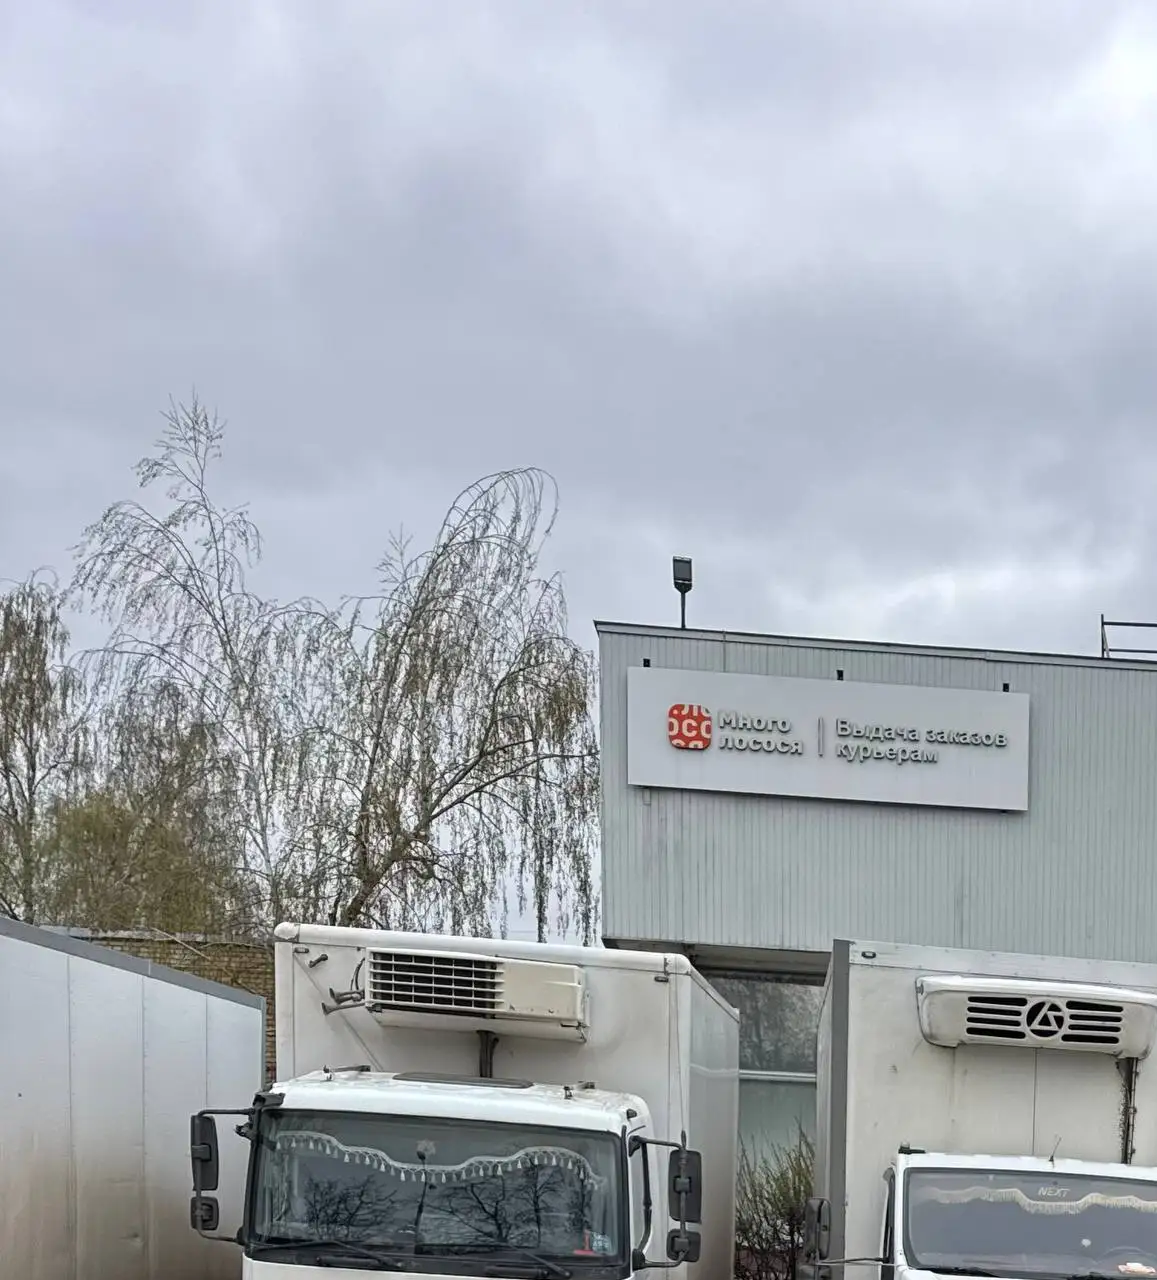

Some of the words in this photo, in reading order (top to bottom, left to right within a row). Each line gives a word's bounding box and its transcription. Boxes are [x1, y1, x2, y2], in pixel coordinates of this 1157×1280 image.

[836, 718, 920, 742] Выдача
[926, 727, 1008, 747] заказов
[719, 735, 803, 754] лосося
[836, 743, 938, 764] курьерам
